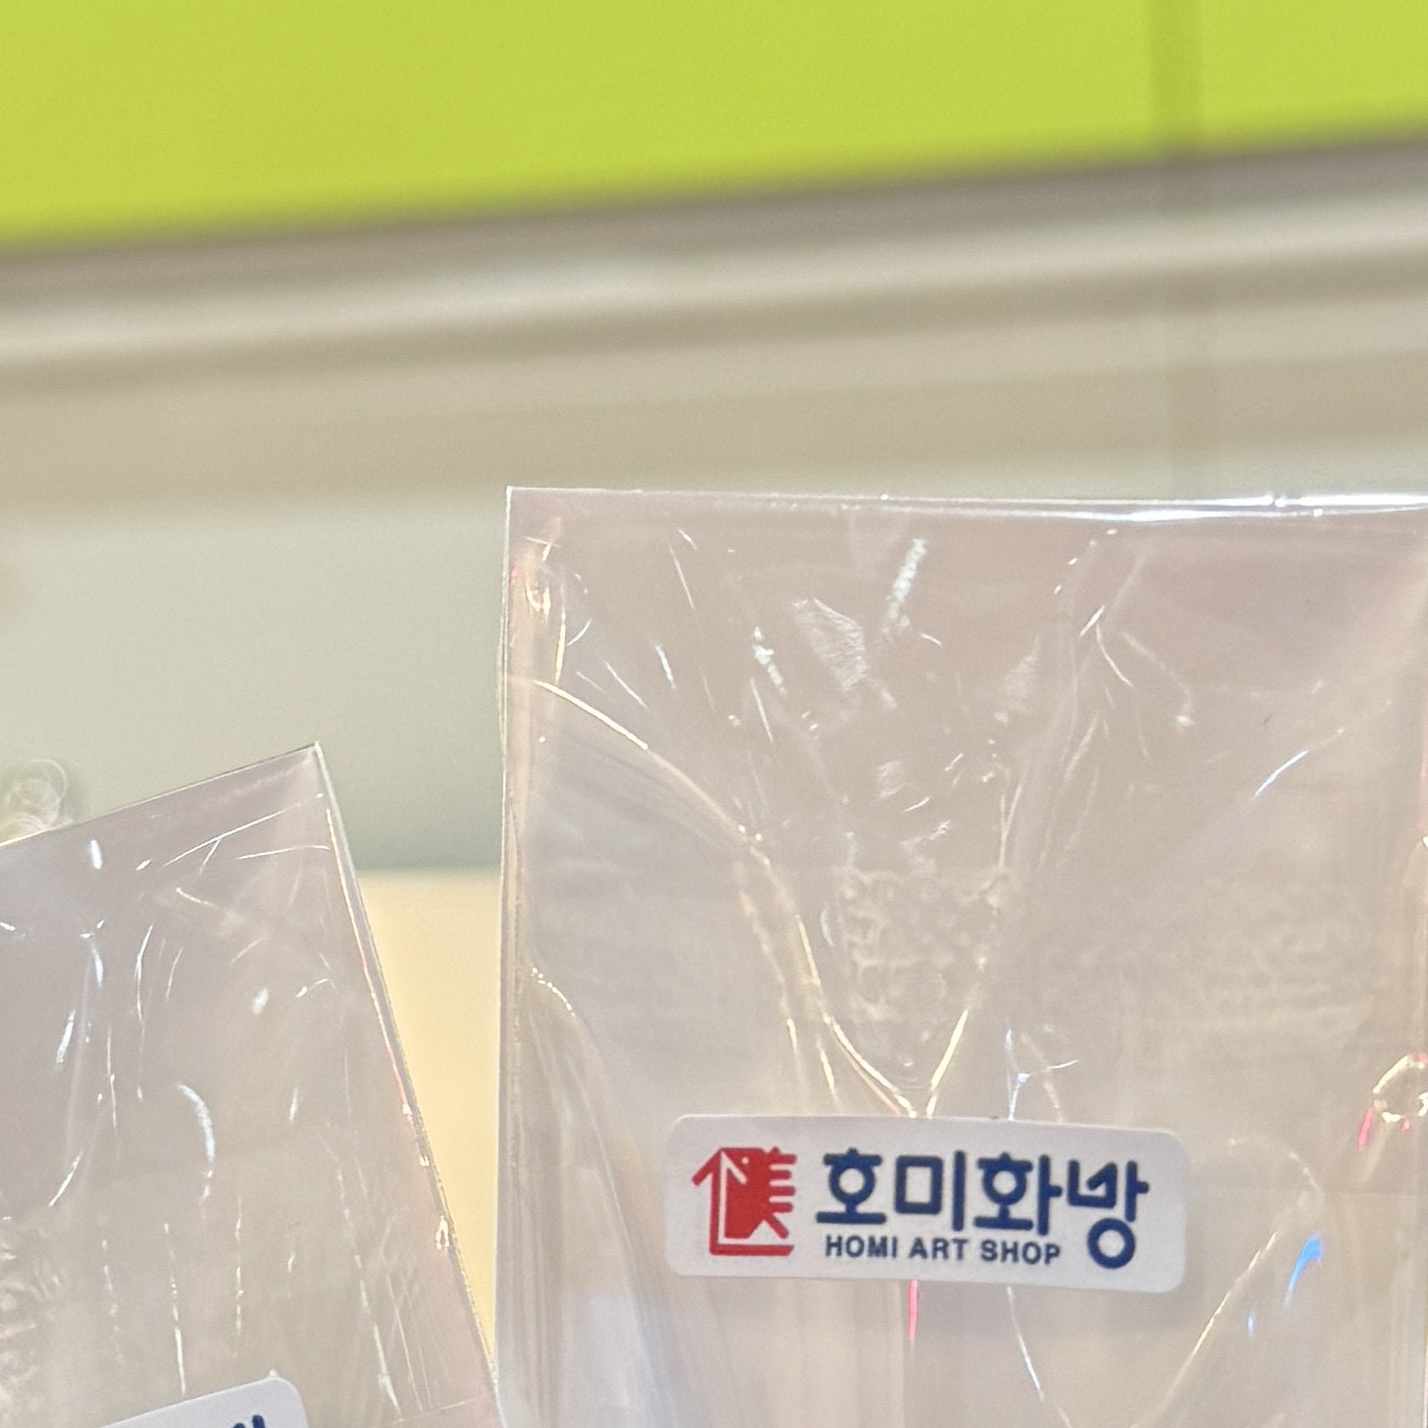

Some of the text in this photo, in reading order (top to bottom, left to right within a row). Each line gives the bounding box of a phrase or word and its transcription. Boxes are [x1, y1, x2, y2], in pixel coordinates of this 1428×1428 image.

[815, 1147, 1150, 1270] 호미화방
[824, 1234, 1062, 1265] HOMI ART SHOP
